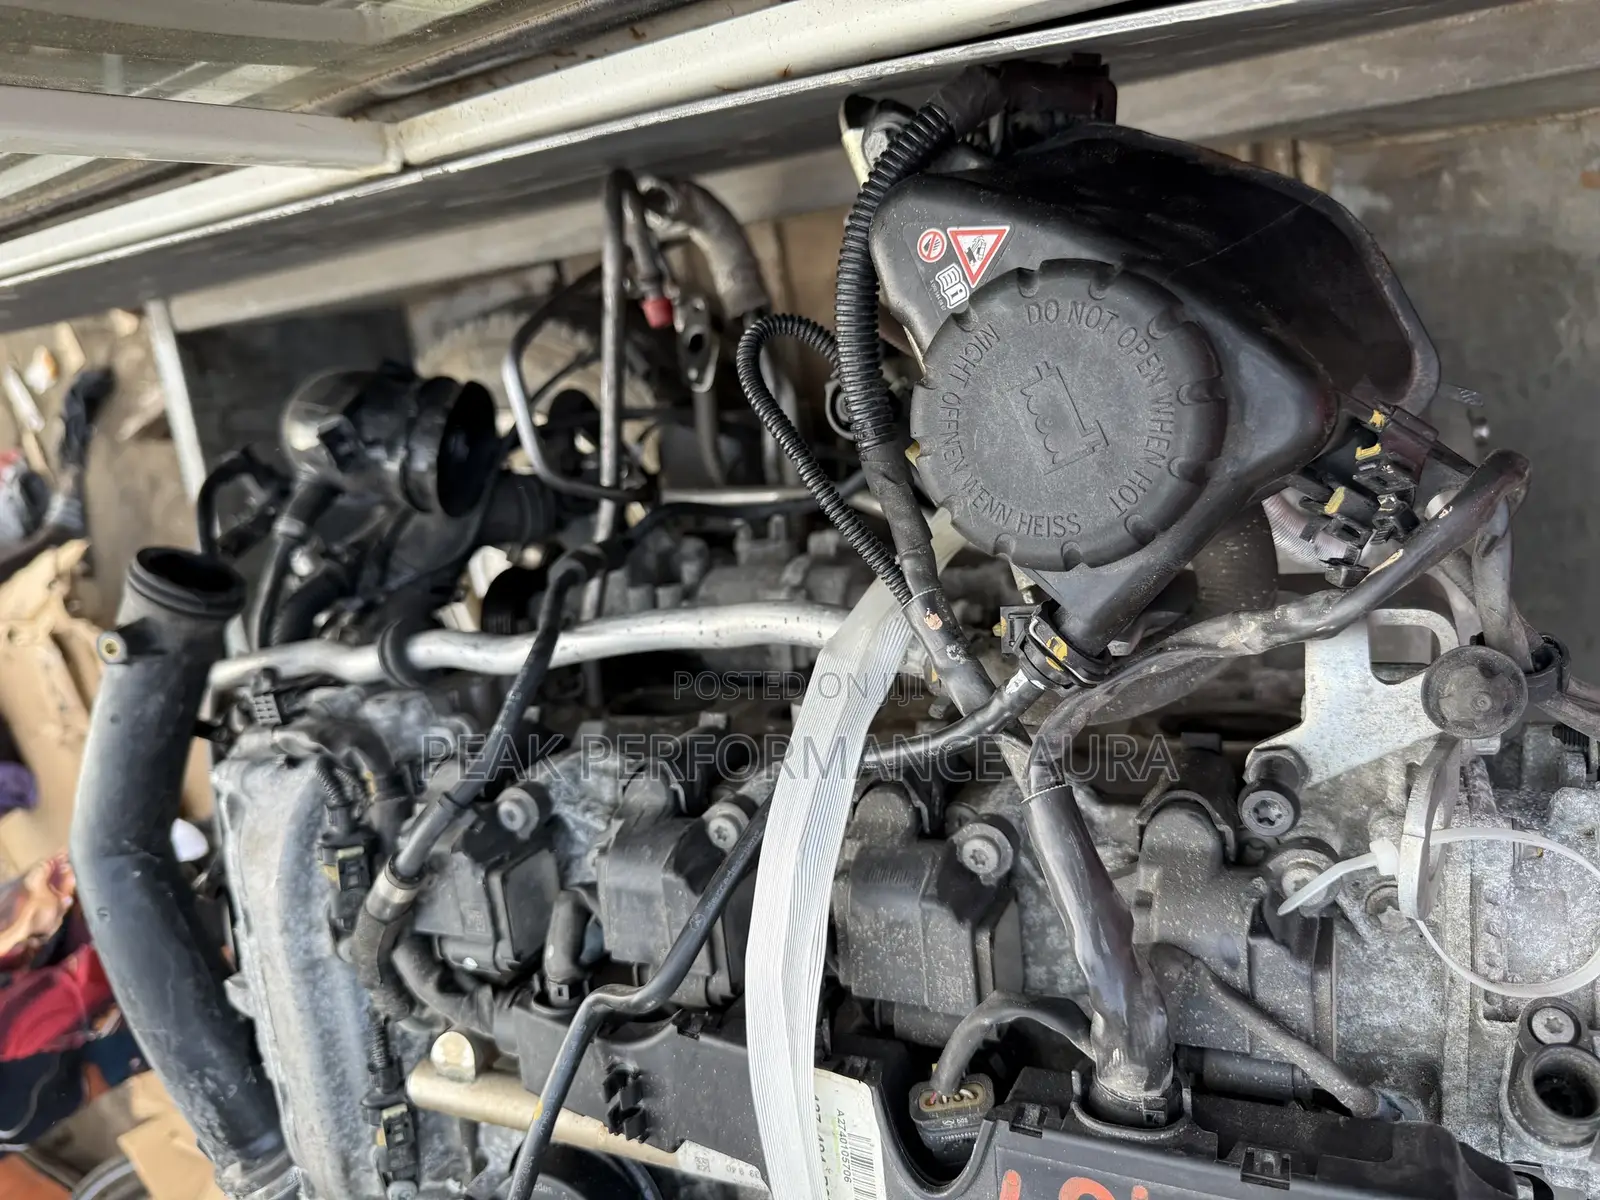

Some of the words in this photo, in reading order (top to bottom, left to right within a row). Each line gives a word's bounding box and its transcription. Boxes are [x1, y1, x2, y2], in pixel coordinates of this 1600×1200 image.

[1026, 299, 1060, 326] DO
[1067, 300, 1119, 335] NOT
[947, 324, 1001, 388] NICHT
[1117, 326, 1168, 388] OPEN
[1144, 393, 1175, 470] WHEN
[963, 474, 1013, 525] WENN
[1109, 470, 1153, 518] HOT
[1016, 512, 1082, 538] HEISS
[836, 1108, 852, 1183] A2740105706
